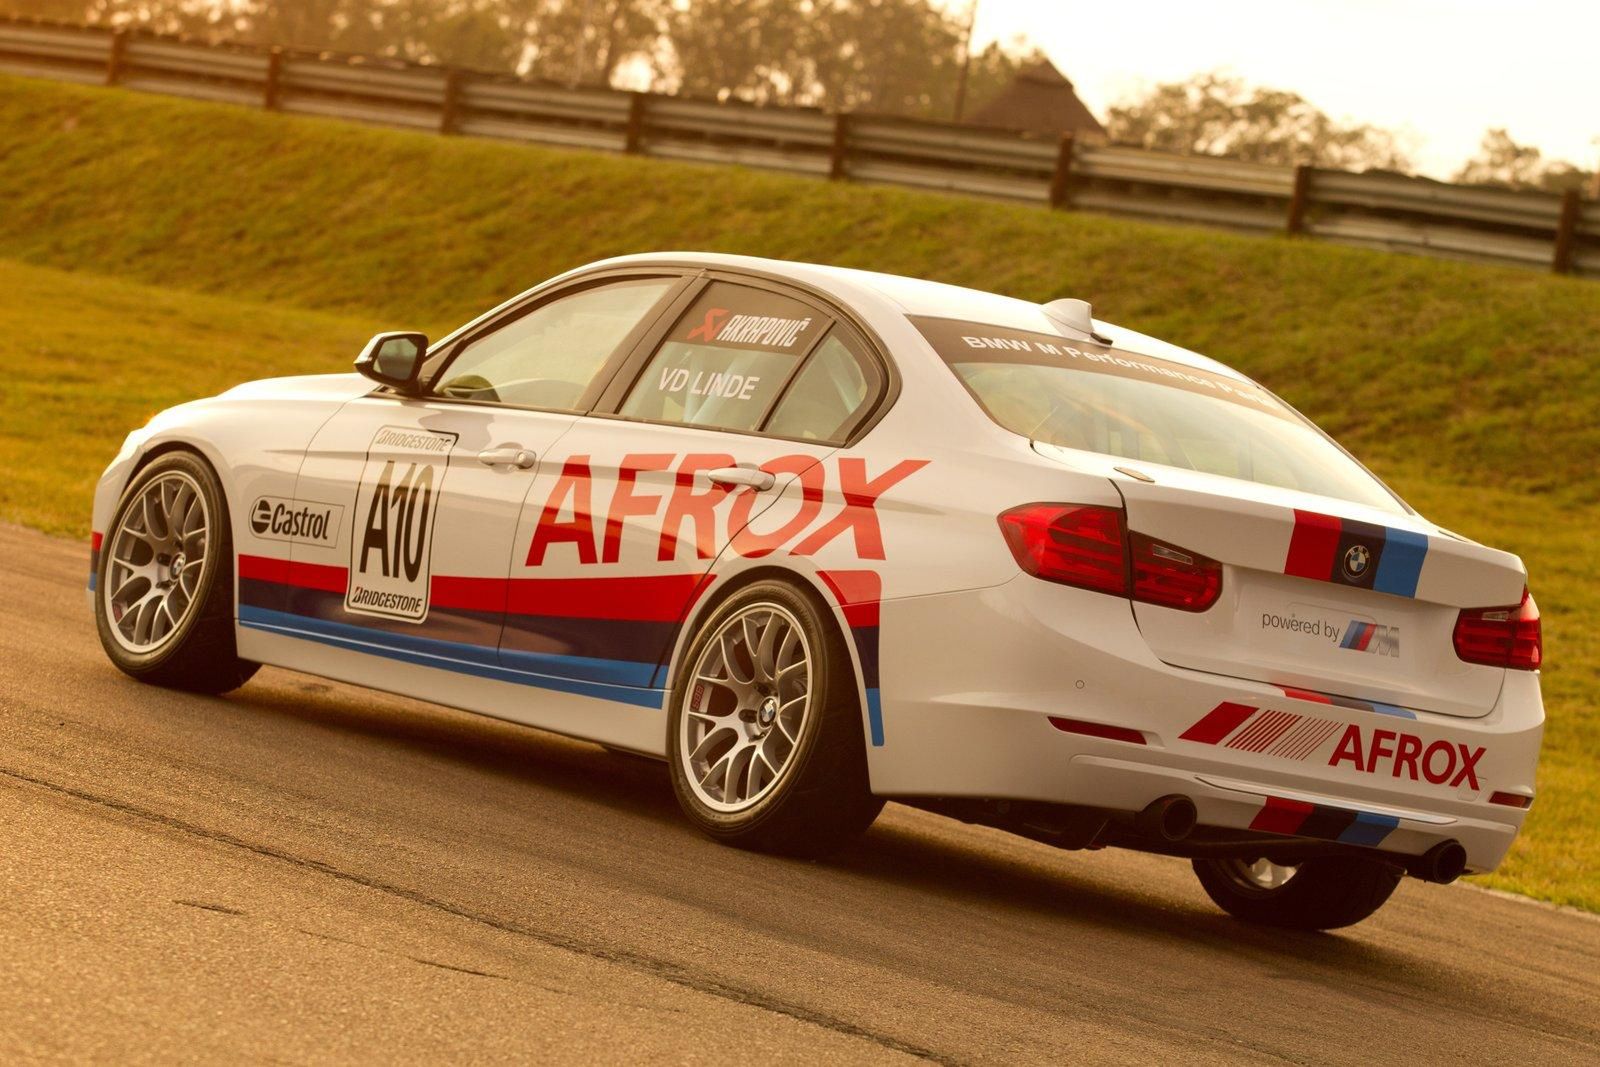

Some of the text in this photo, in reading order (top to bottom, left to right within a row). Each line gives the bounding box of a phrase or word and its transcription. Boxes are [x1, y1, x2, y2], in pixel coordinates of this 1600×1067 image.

[961, 336, 1032, 352] BMW
[1035, 342, 1063, 356] M
[1062, 346, 1217, 389] Performance
[658, 367, 760, 400] VD LINDE
[376, 429, 452, 452] BRIDGESTONE
[271, 503, 331, 540] Castrol
[359, 460, 434, 583] A10
[525, 453, 932, 566] AFROX
[352, 586, 423, 613] BRIDGESTONE
[1262, 613, 1320, 635] powered
[1324, 621, 1340, 642] by
[1328, 724, 1487, 791] AFROX
